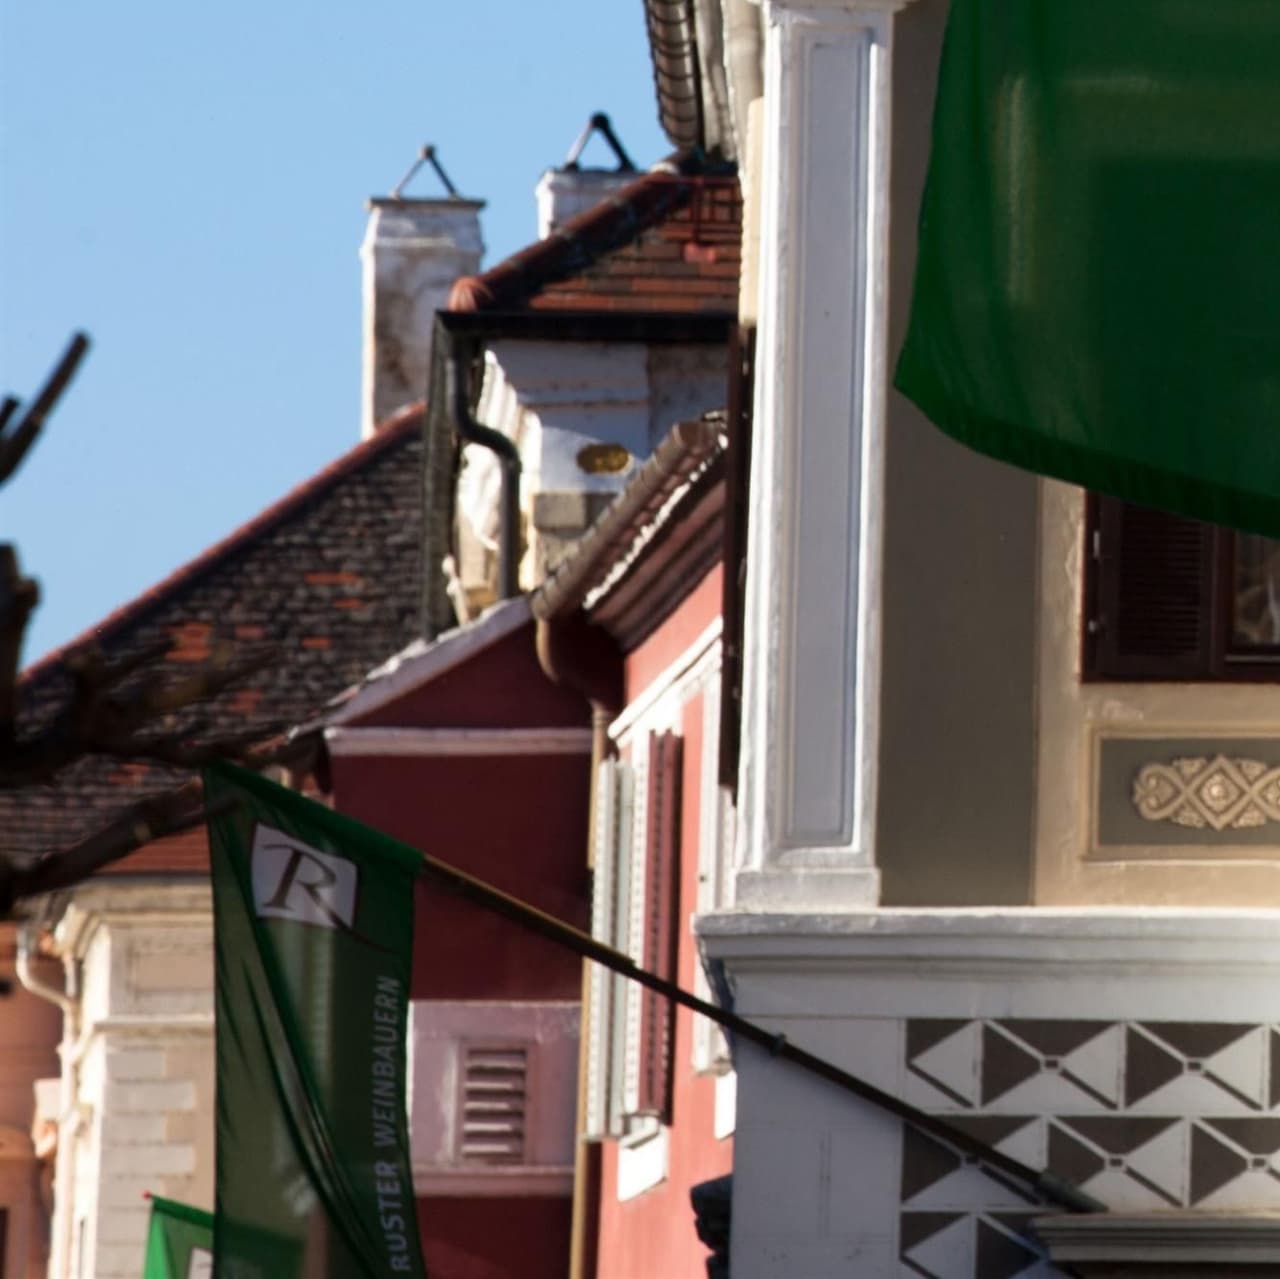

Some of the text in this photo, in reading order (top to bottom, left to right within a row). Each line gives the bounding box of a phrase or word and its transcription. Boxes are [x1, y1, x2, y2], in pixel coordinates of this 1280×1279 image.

[263, 844, 400, 952] R
[372, 975, 411, 1272] RUSTER WEINBAUERN
